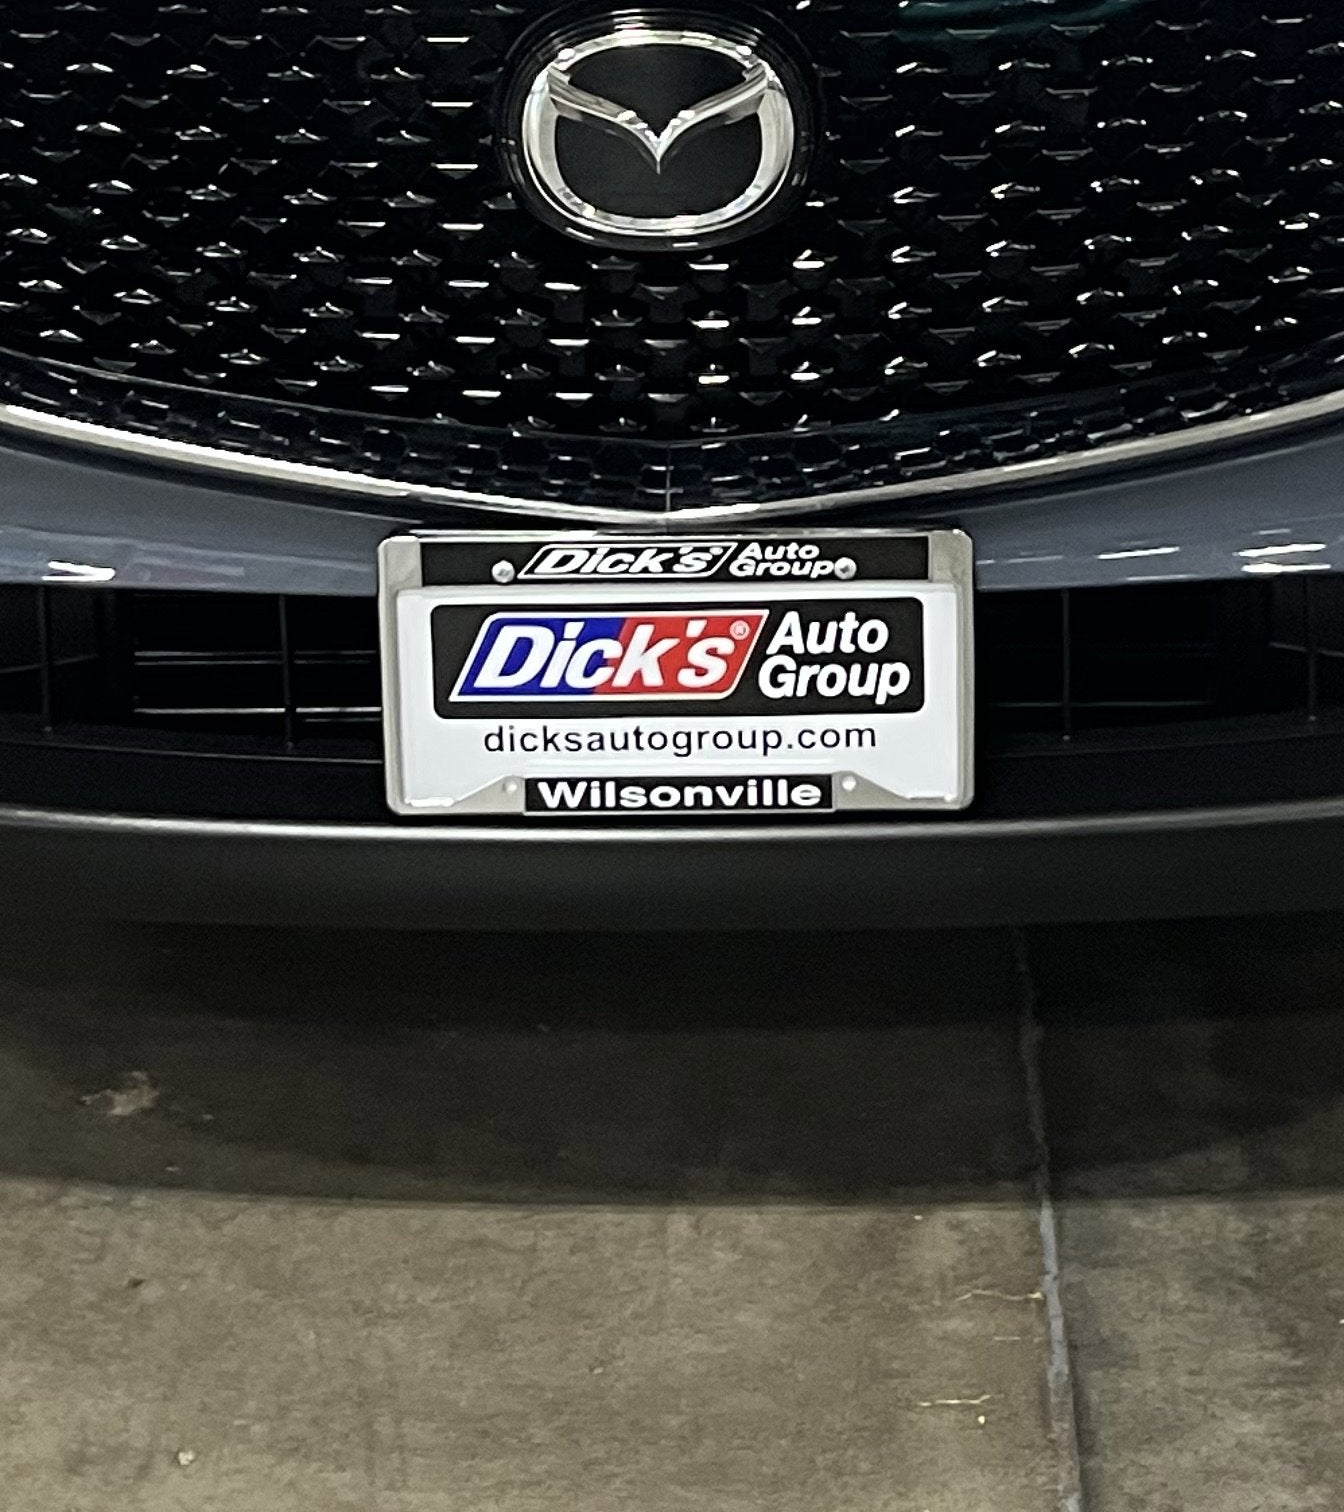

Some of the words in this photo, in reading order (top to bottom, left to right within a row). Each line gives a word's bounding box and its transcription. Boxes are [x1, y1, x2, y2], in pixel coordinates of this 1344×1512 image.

[534, 544, 713, 576] Dick's
[742, 541, 820, 560] Auto
[729, 557, 835, 579] Group
[766, 611, 889, 655] Auto
[473, 620, 734, 690] Dick's
[757, 655, 911, 705] Group
[483, 724, 878, 757] dicksautogroup.com
[536, 779, 823, 810] Wilsonville
